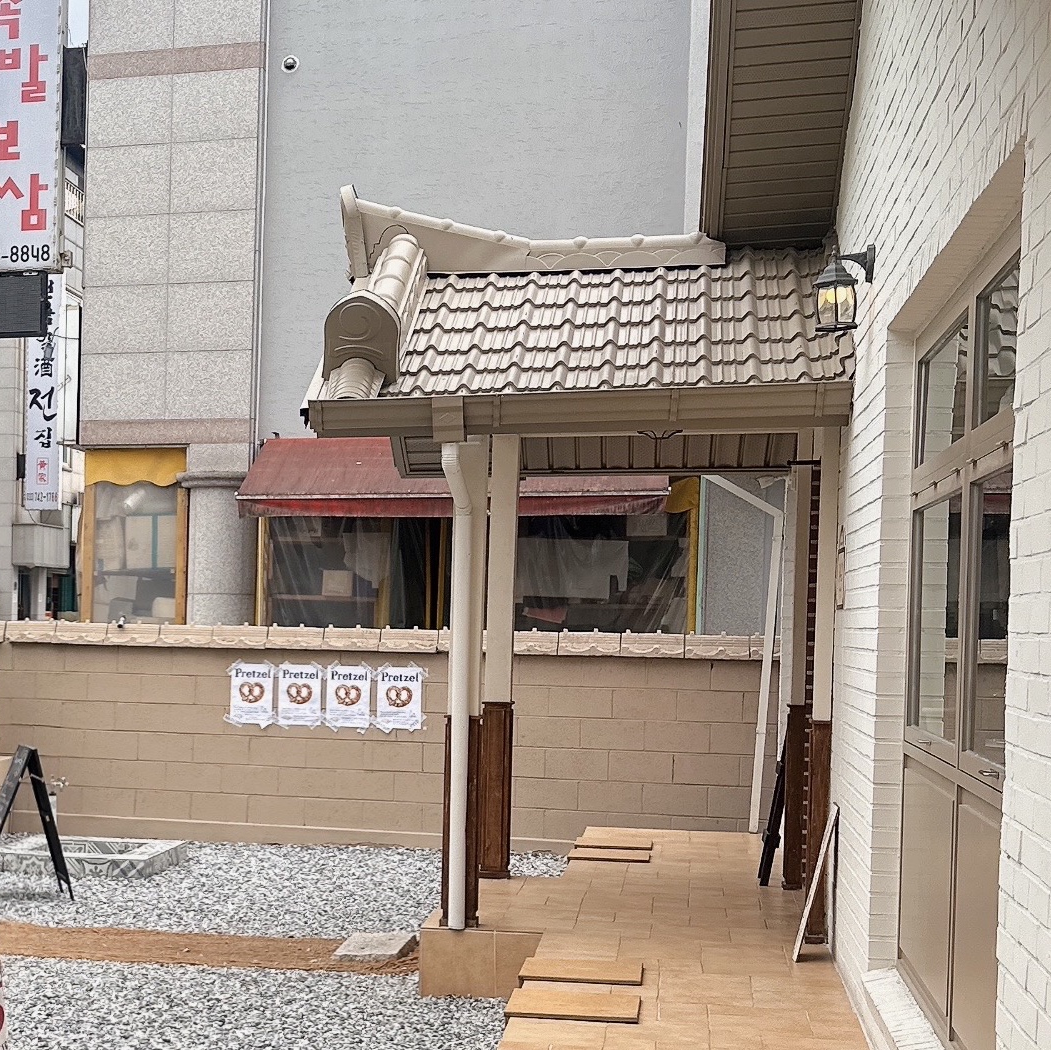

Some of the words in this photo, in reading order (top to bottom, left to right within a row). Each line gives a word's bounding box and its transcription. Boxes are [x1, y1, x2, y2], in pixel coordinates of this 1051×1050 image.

[235, 667, 271, 679] Pretzel
[282, 668, 319, 679] Pretzel
[331, 670, 368, 681] Pretzel
[381, 671, 419, 682] Pretzel
